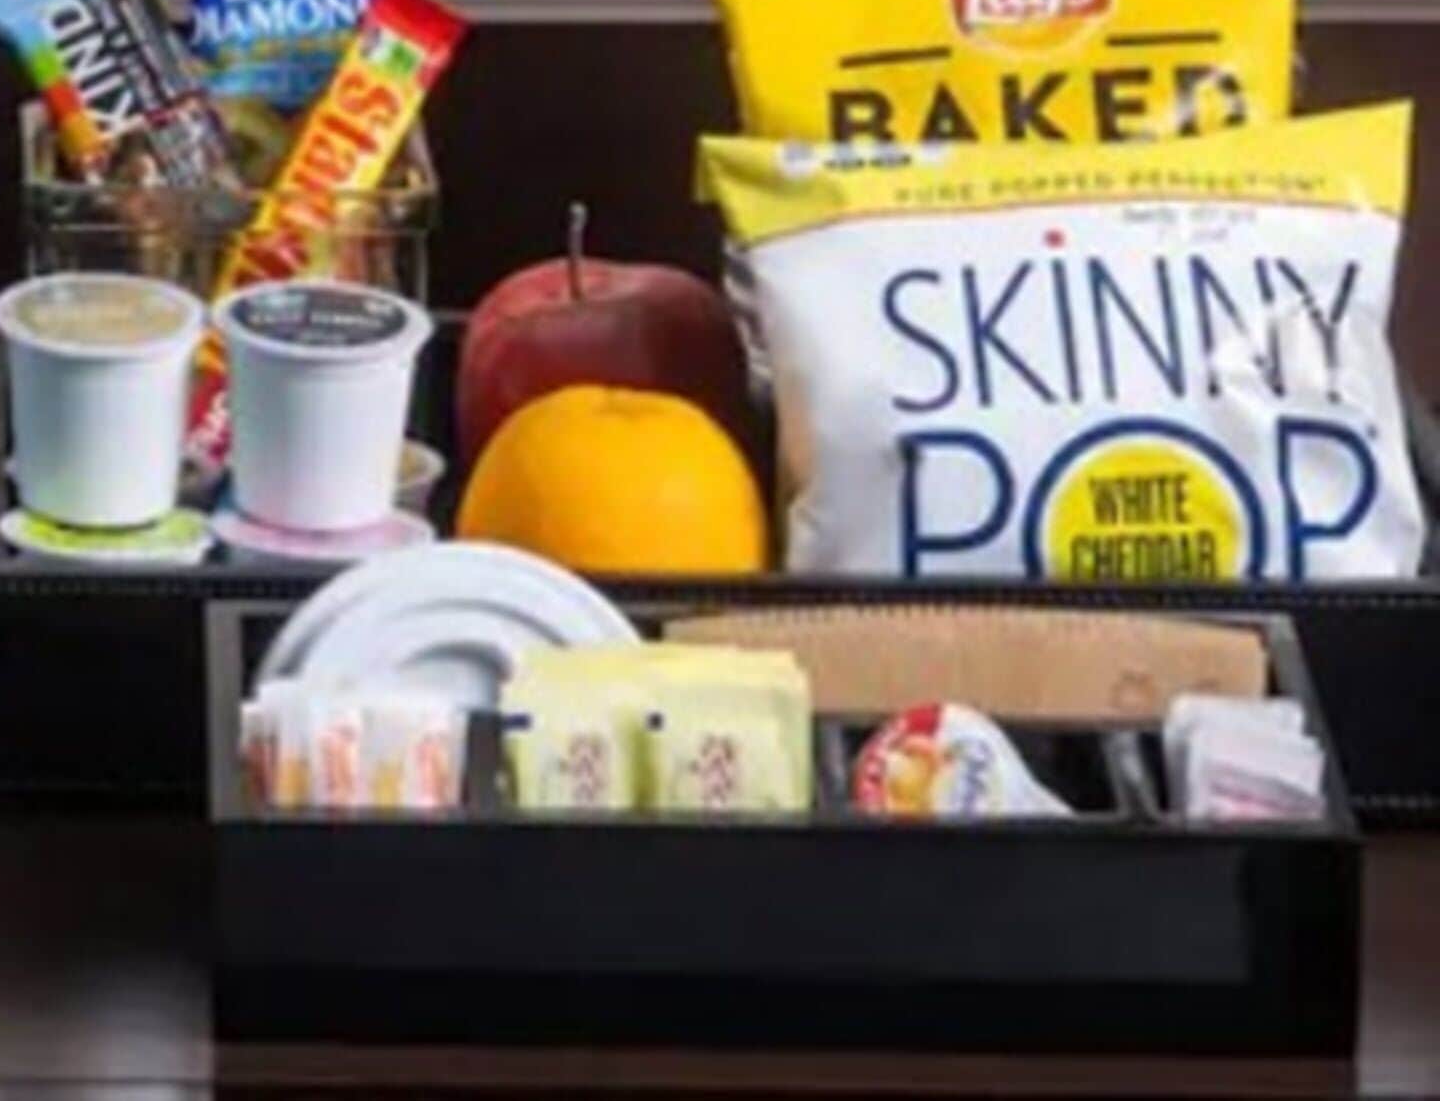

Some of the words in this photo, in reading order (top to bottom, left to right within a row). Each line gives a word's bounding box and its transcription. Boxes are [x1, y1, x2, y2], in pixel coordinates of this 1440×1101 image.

[42, 0, 148, 142] KIND
[830, 64, 1250, 144] BAKED
[883, 228, 1359, 414] SKINNY
[896, 415, 1379, 582] POP
[1087, 473, 1192, 527] WHITE
[1070, 528, 1218, 582] CHEDDAR
